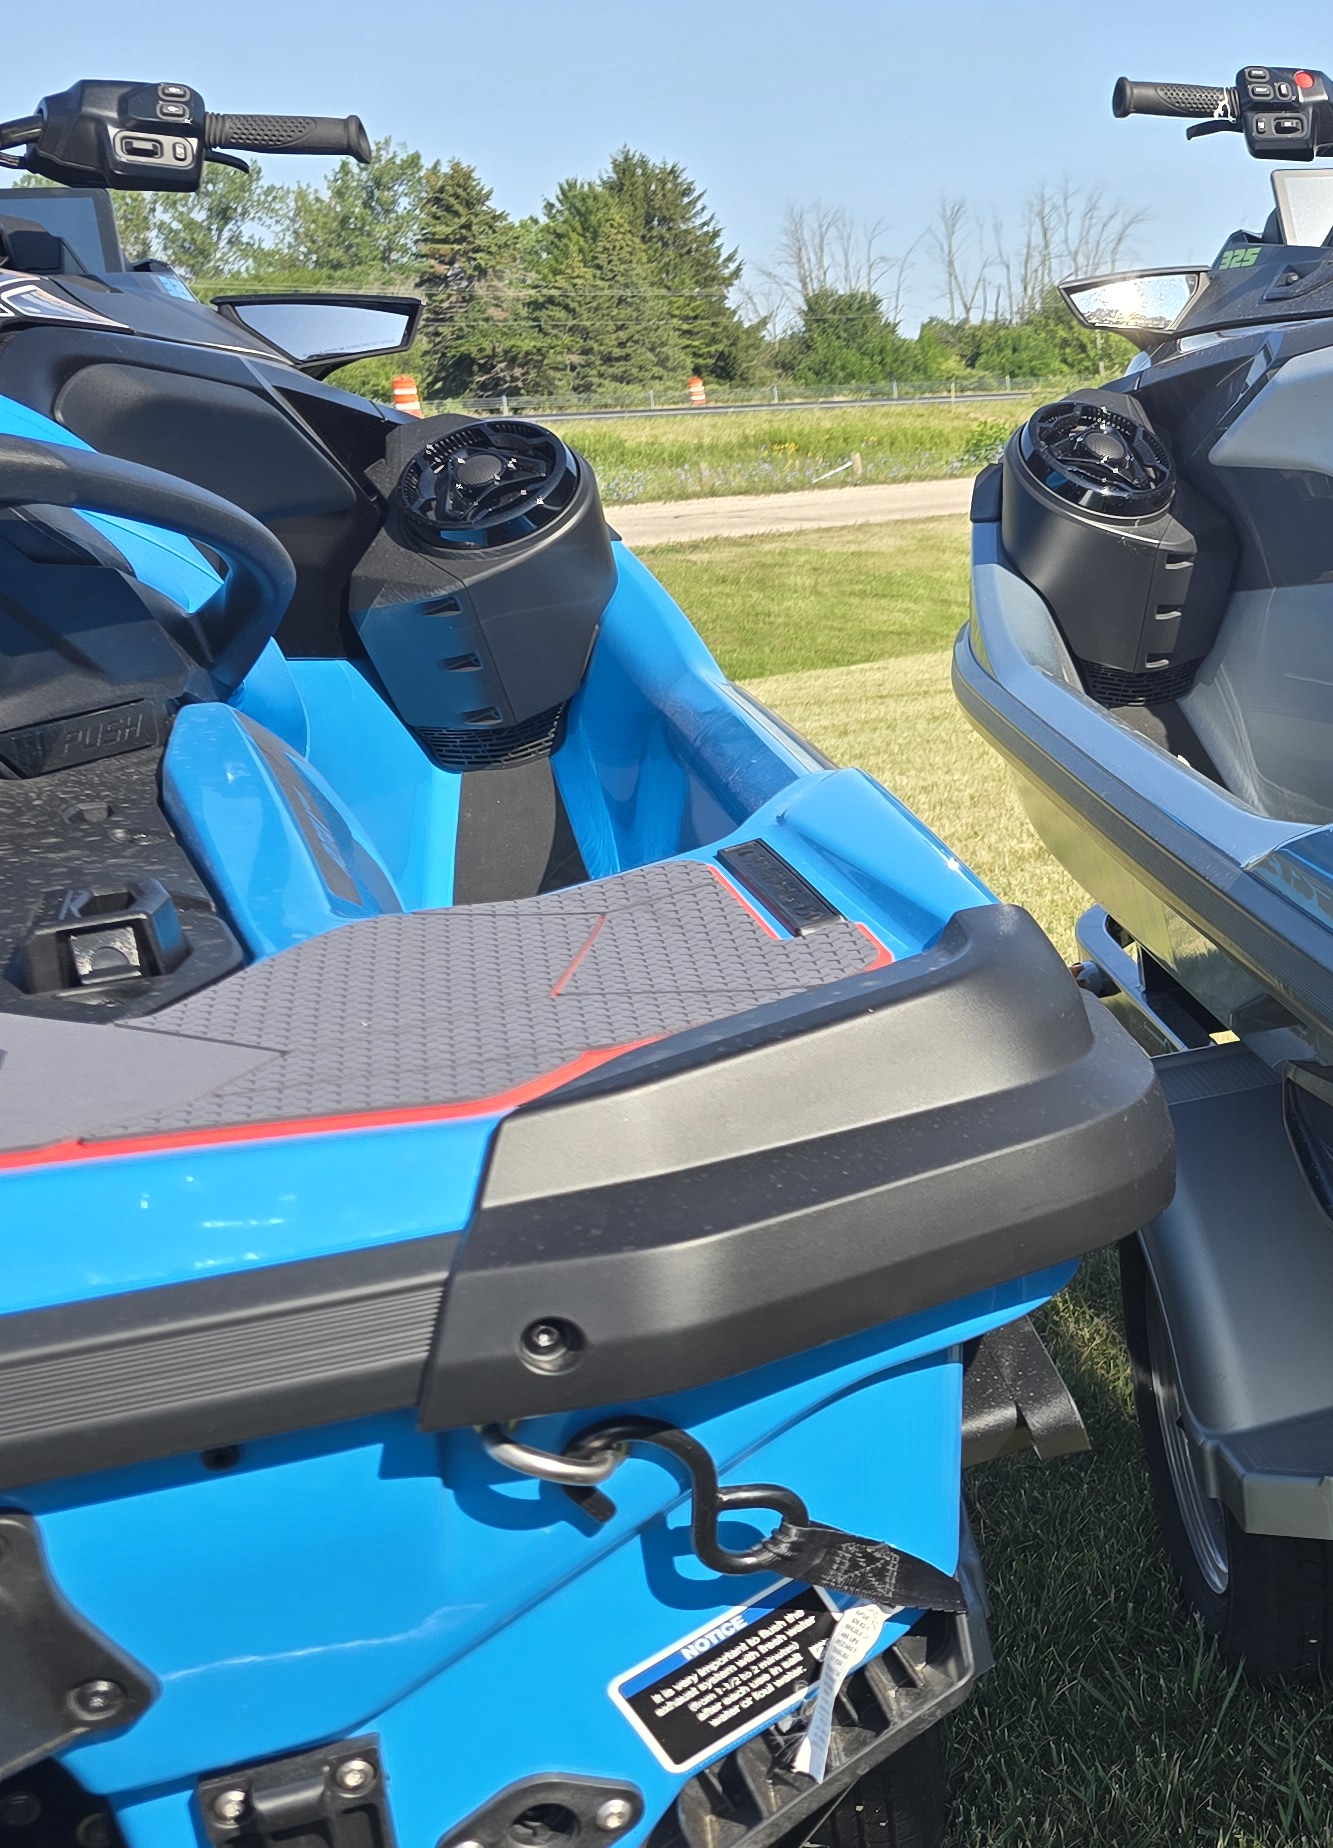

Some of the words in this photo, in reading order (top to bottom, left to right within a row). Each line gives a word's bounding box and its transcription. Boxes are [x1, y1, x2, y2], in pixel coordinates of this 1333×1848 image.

[1219, 247, 1262, 270] 325
[64, 714, 143, 757] PUSH
[673, 1674, 698, 1690] very
[696, 1643, 750, 1676] important
[758, 1621, 787, 1639] flush
[678, 1613, 748, 1662] NOTICE
[655, 1687, 699, 1716] exhaust
[696, 1665, 739, 1691] system
[734, 1651, 760, 1667] with
[758, 1635, 787, 1653] fresh
[785, 1616, 815, 1637] water
[697, 1702, 723, 1721] after
[722, 1686, 750, 1705] each
[708, 1705, 740, 1726] water
[752, 1682, 775, 1700] foul
